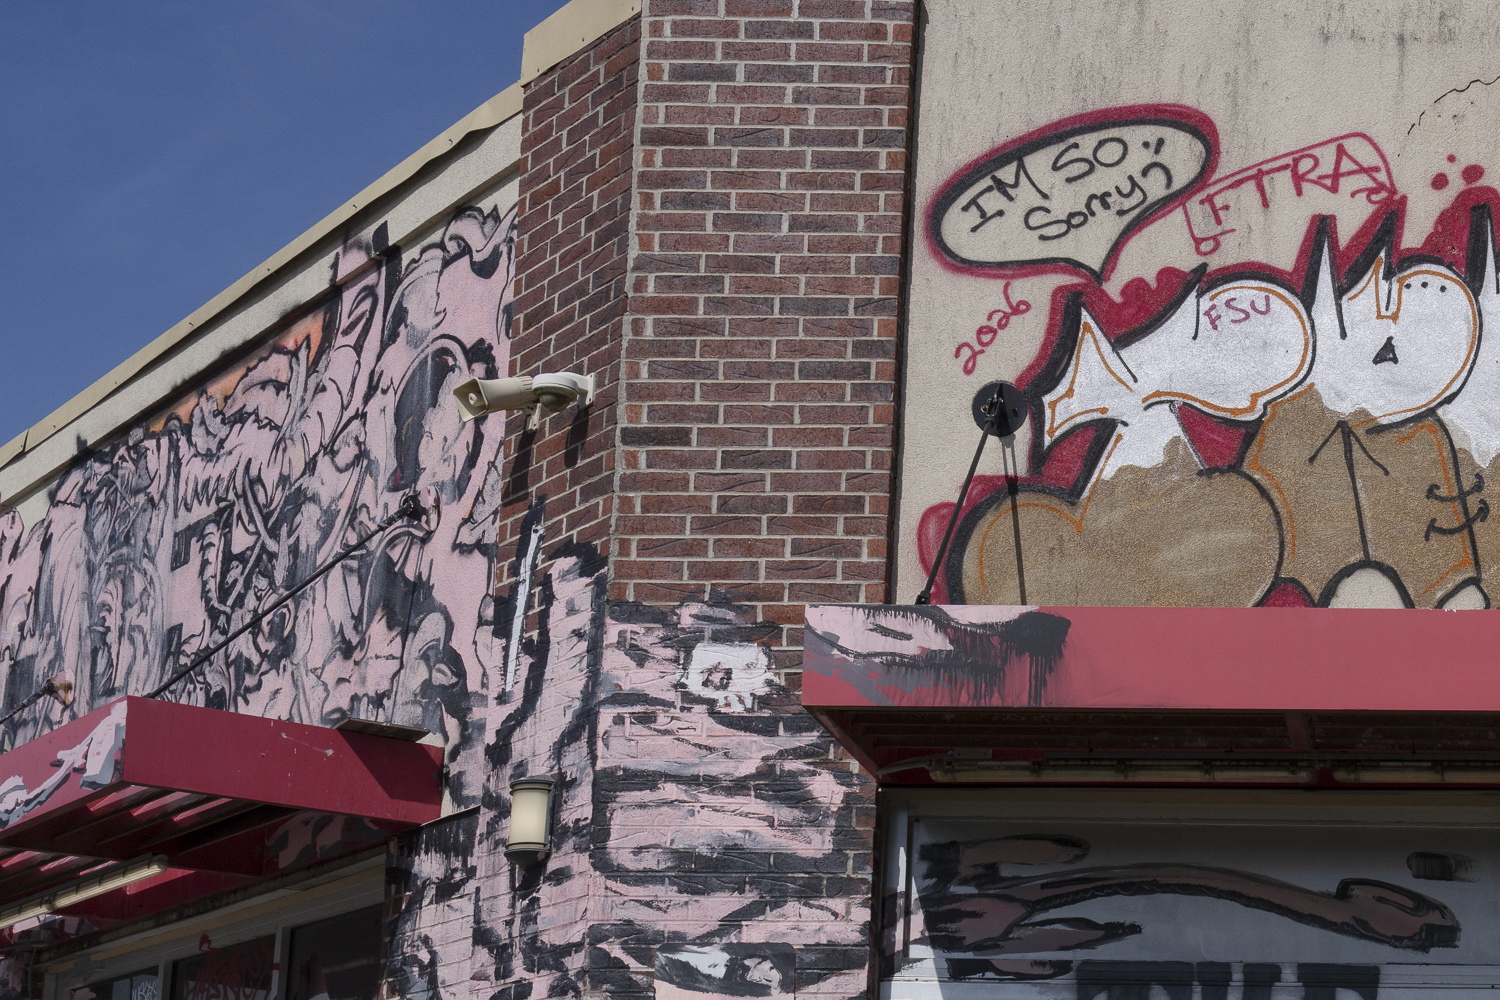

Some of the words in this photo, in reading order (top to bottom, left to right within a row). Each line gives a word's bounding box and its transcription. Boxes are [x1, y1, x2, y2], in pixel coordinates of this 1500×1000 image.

[1050, 137, 1128, 183] SO
[954, 281, 1031, 376] 2026
[1203, 294, 1272, 331] FSU
